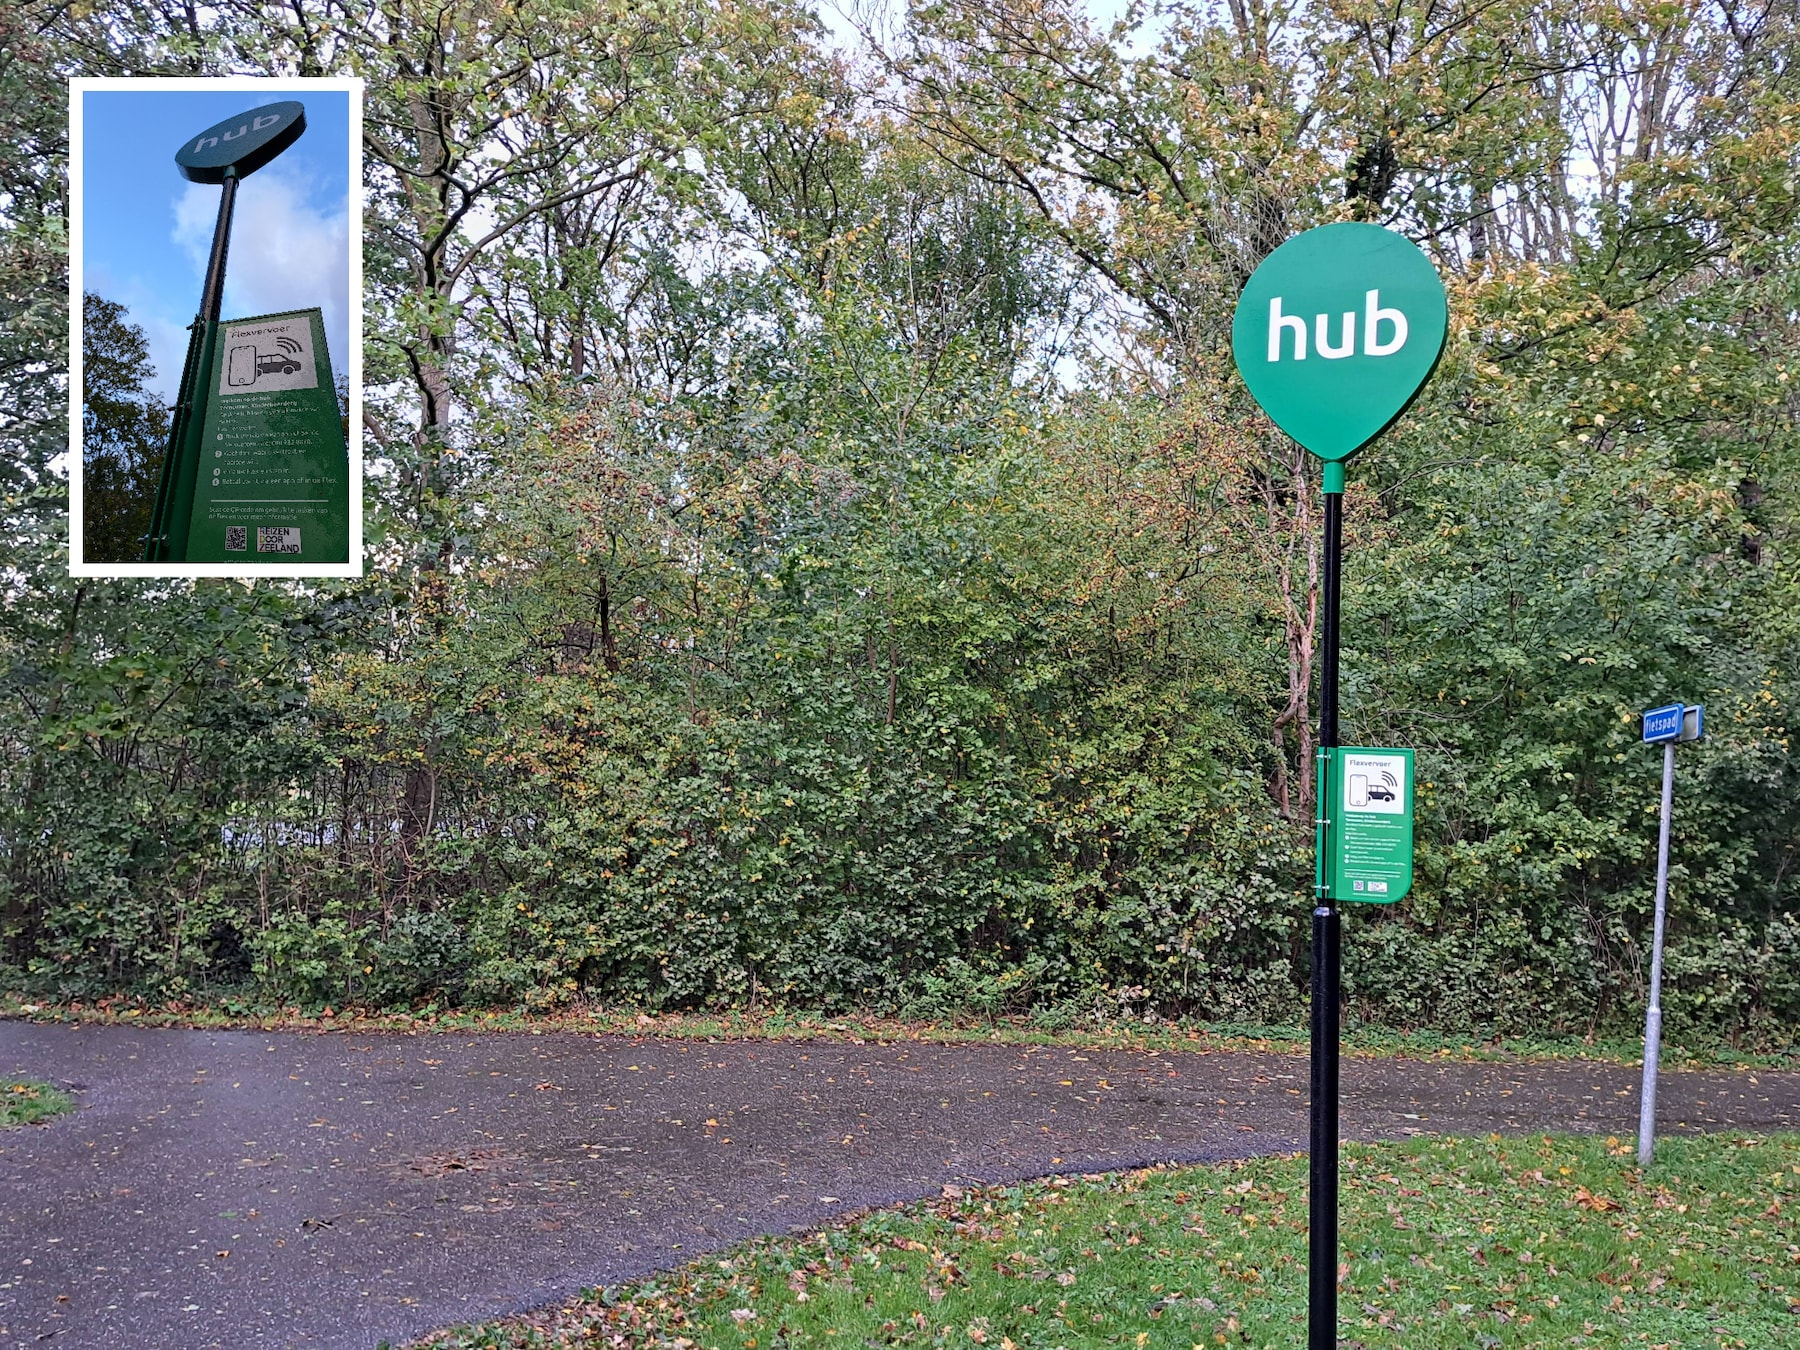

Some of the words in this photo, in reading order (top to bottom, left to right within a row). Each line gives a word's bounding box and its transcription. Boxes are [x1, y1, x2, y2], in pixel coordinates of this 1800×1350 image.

[194, 114, 280, 153] hub
[1267, 289, 1408, 362] hub
[232, 325, 290, 338] Flexvervoer
[260, 527, 290, 536] REIZEN
[260, 535, 284, 544] DOOR
[259, 543, 300, 553] ZEELAND
[1349, 759, 1391, 767] Flexvervoer
